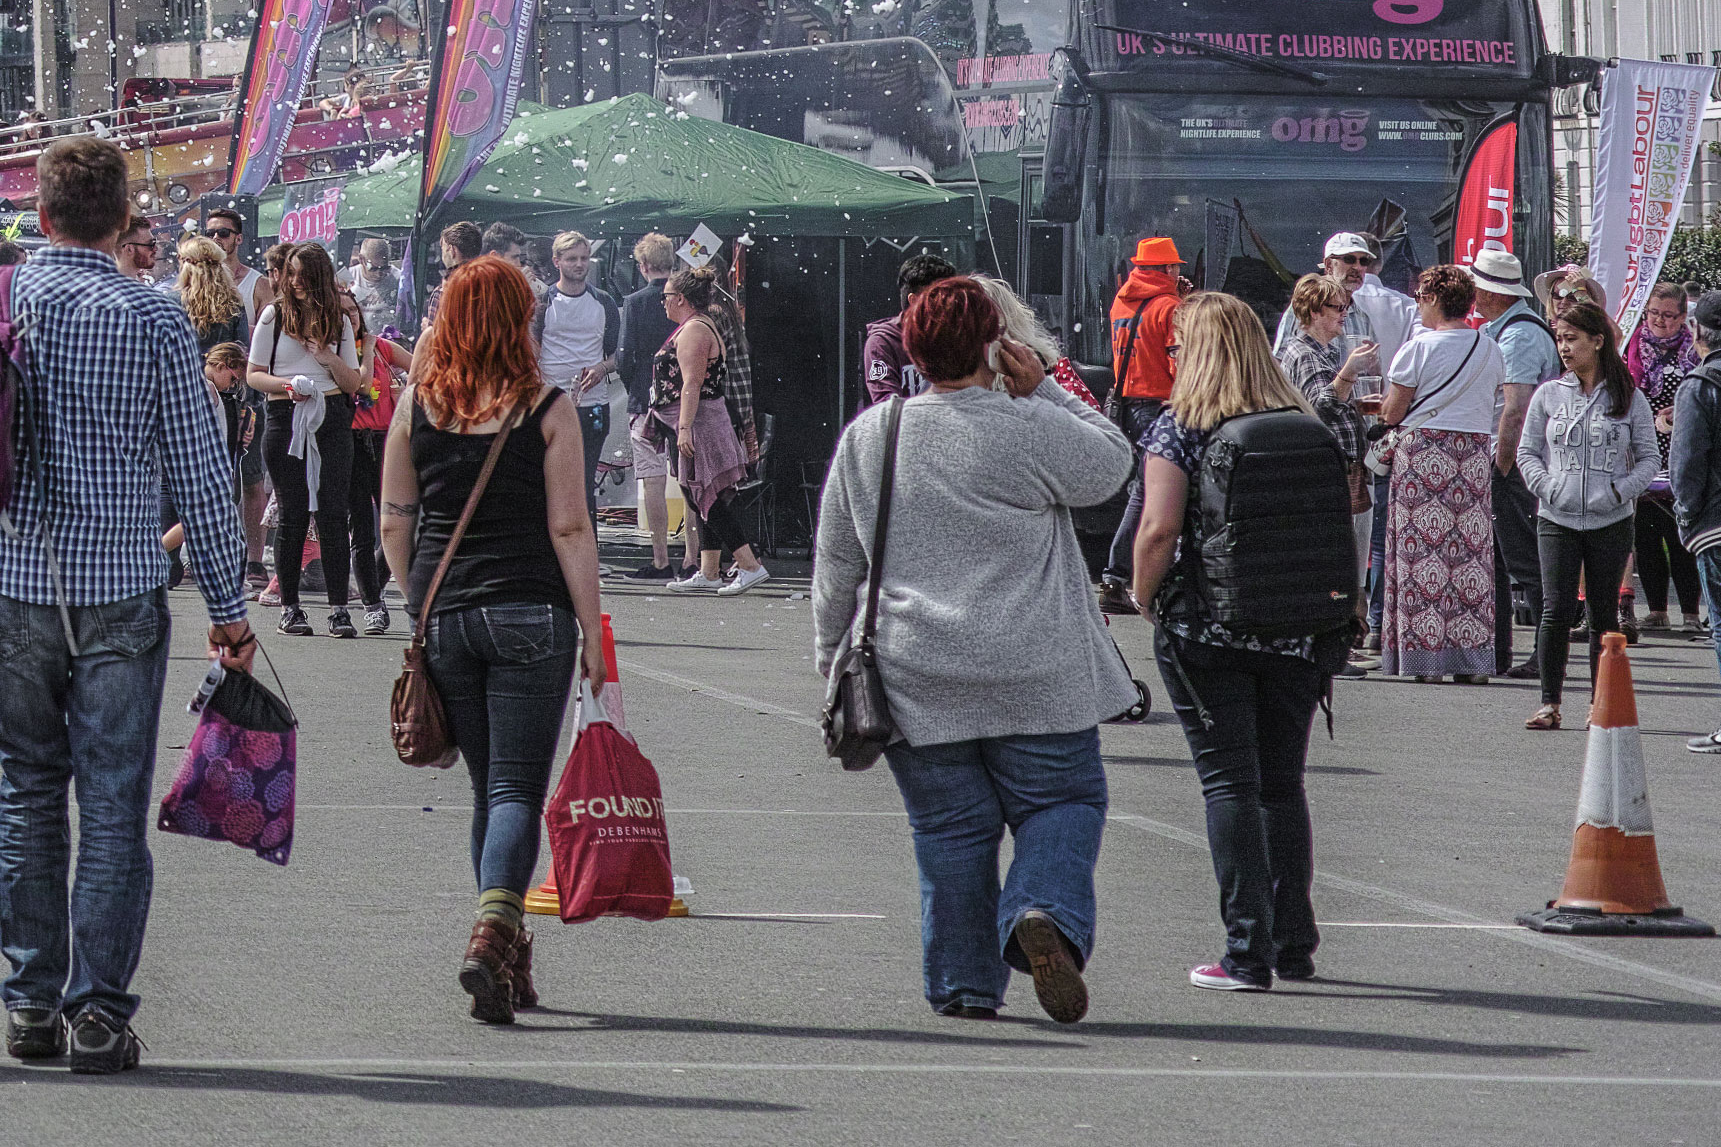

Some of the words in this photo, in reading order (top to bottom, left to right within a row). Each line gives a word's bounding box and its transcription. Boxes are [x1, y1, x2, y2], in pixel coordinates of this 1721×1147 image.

[1279, 34, 1382, 60] CLUBBING
[1389, 38, 1516, 65] EXPERIENCE
[1181, 118, 1195, 127] THE
[1196, 118, 1213, 127] UK'S
[1379, 120, 1399, 129] VISIT
[1400, 121, 1410, 130] US
[1411, 121, 1437, 130] ONLINE
[1687, 90, 1700, 131] equality
[1181, 129, 1217, 138] NIGHTLIFE
[1218, 130, 1261, 139] EXPERIENCE
[1272, 113, 1369, 151] omg
[1682, 135, 1694, 169] deliver
[279, 199, 338, 244] omg
[568, 795, 654, 824] FOUND
[597, 826, 662, 838] DEBENHAMS
